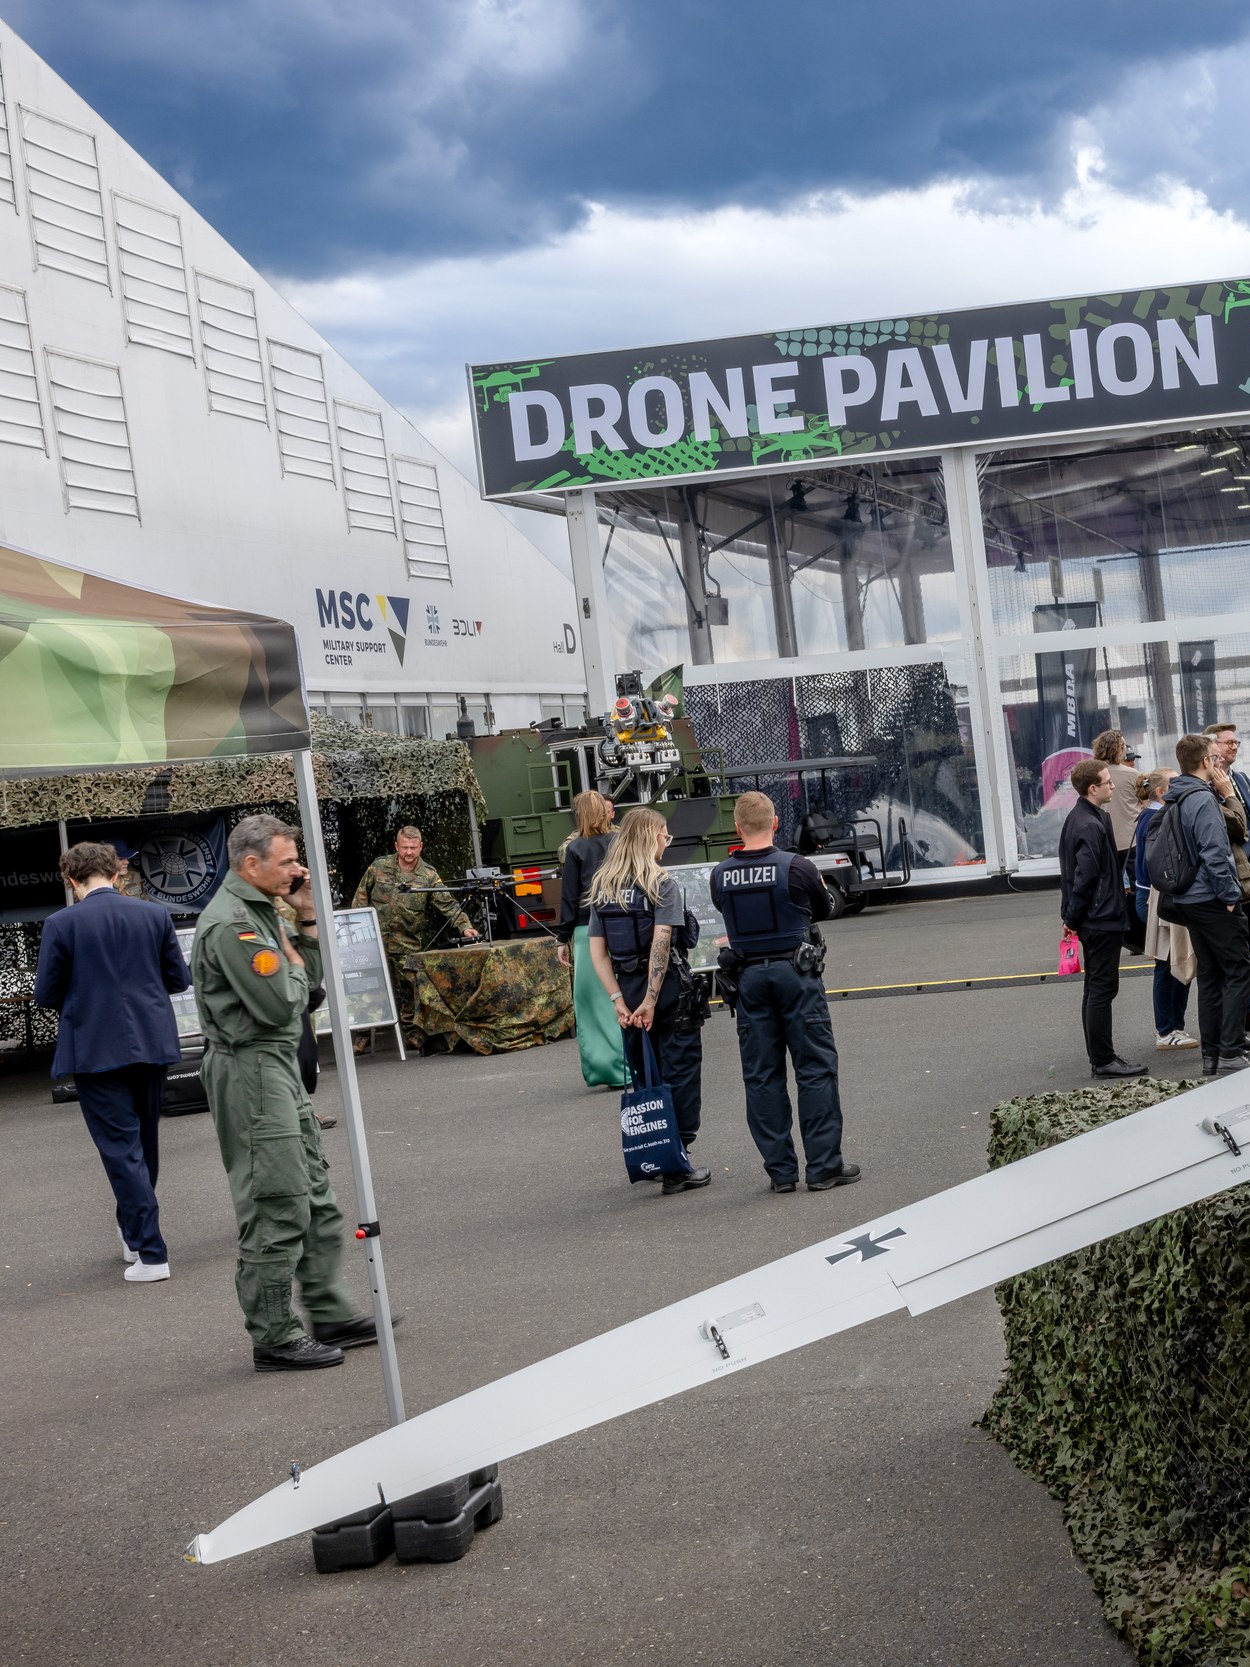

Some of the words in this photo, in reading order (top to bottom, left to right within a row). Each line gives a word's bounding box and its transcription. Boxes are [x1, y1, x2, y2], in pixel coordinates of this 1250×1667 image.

[507, 361, 805, 462] DRONE
[823, 314, 1219, 426] PAVILION
[316, 588, 373, 631] MSC
[323, 640, 354, 651] MILITARY
[356, 642, 386, 653] SUPPORT
[325, 654, 353, 666] CENTER
[1065, 663, 1077, 738] MBDA
[723, 866, 776, 887] POLIZEI
[156, 875, 213, 903] BUNDESWEHR
[627, 1100, 664, 1116] PASSION
[628, 1115, 645, 1126] FOR
[629, 1119, 668, 1136] ENGINES
[1230, 1166, 1242, 1175] NO
[711, 1365, 724, 1373] NO
